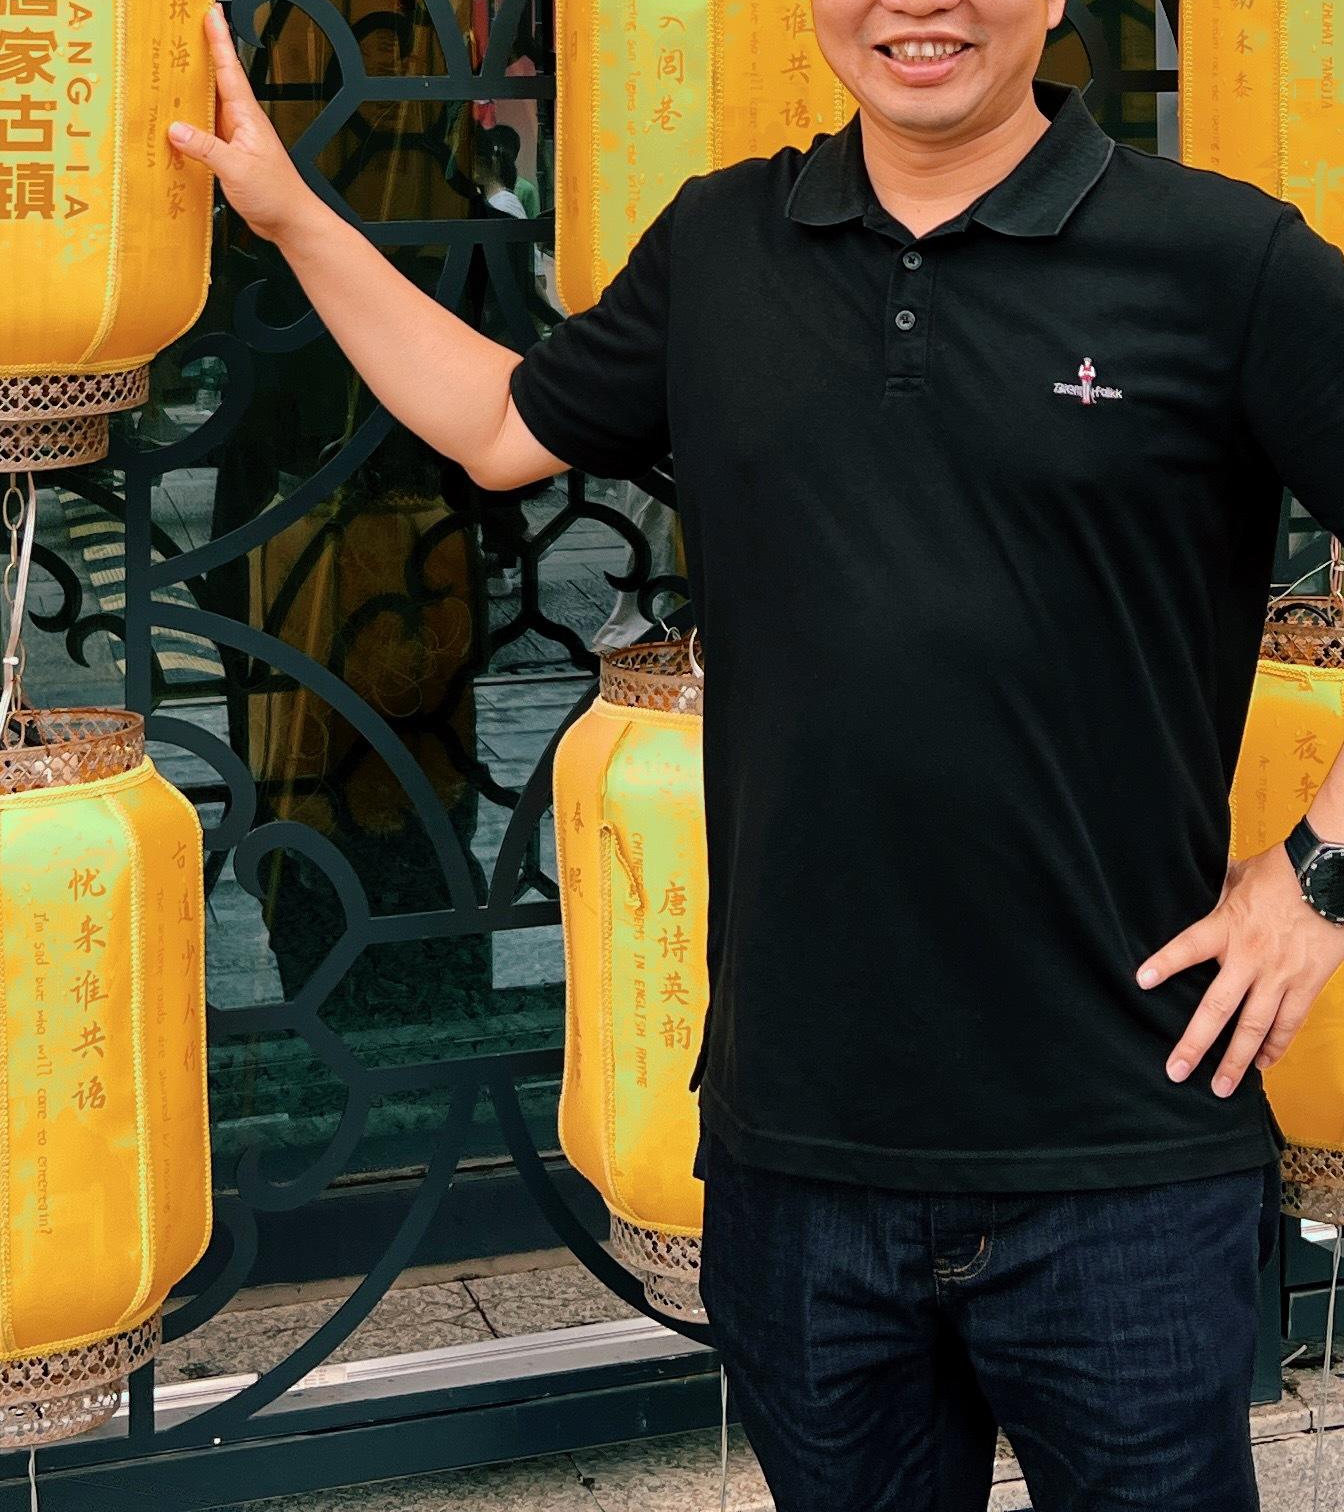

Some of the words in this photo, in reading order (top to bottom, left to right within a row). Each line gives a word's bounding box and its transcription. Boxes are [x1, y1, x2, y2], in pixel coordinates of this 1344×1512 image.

[1321, 1, 1333, 47] ZHUHAI
[151, 39, 161, 92] ZHUHAI
[1321, 57, 1333, 109] TANGJIA
[146, 105, 158, 168] TANGJIA
[34, 942, 48, 965] sad
[633, 953, 645, 969] IN
[657, 880, 691, 1051] 唐诗英韵
[35, 977, 46, 1000] but
[69, 866, 109, 1113] 忧来谁共语
[633, 980, 647, 1037] ENGLISH
[35, 1010, 49, 1035] who
[36, 1044, 53, 1076] will
[635, 1047, 647, 1088] RHYME
[37, 1128, 47, 1146] to
